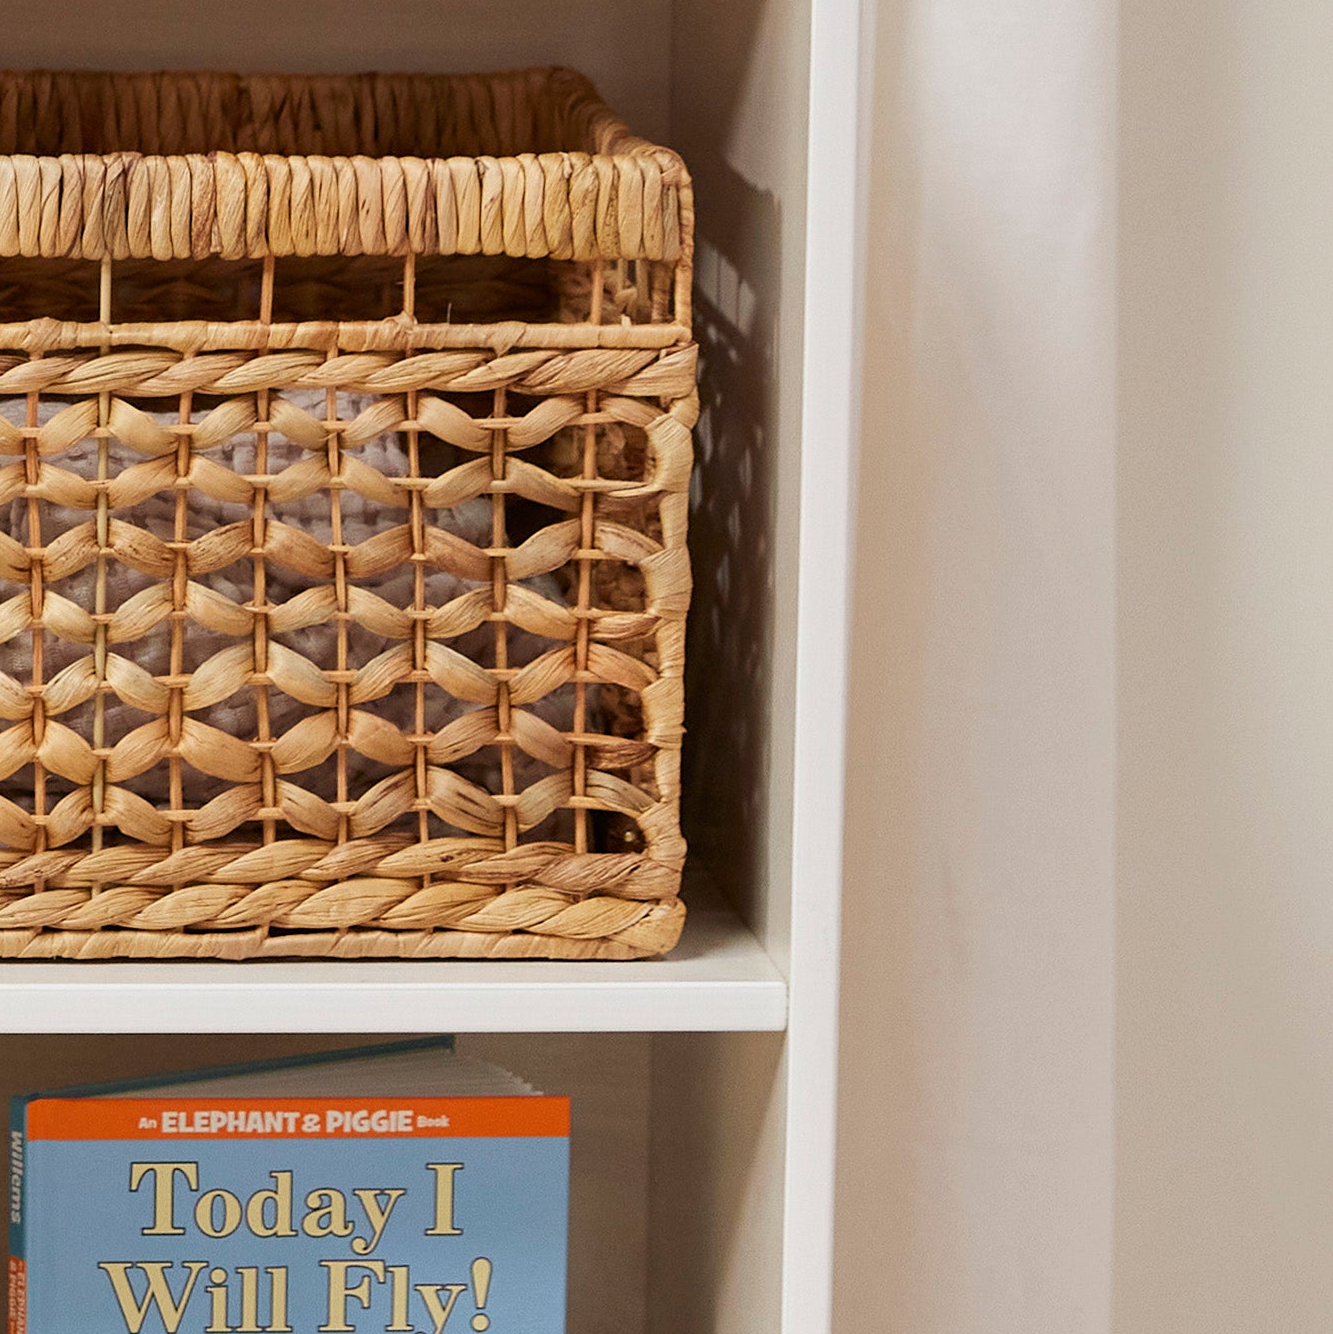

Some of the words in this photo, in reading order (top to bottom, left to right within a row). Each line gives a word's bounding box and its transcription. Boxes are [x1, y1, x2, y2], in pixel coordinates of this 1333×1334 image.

[138, 1117, 157, 1129] An
[161, 1110, 301, 1134] ELEPHANT
[301, 1113, 321, 1133] &
[325, 1109, 415, 1134] PIGGIE
[416, 1115, 450, 1129] Book
[128, 1161, 407, 1255] Today
[424, 1162, 465, 1236] I
[97, 1260, 294, 1334] Will
